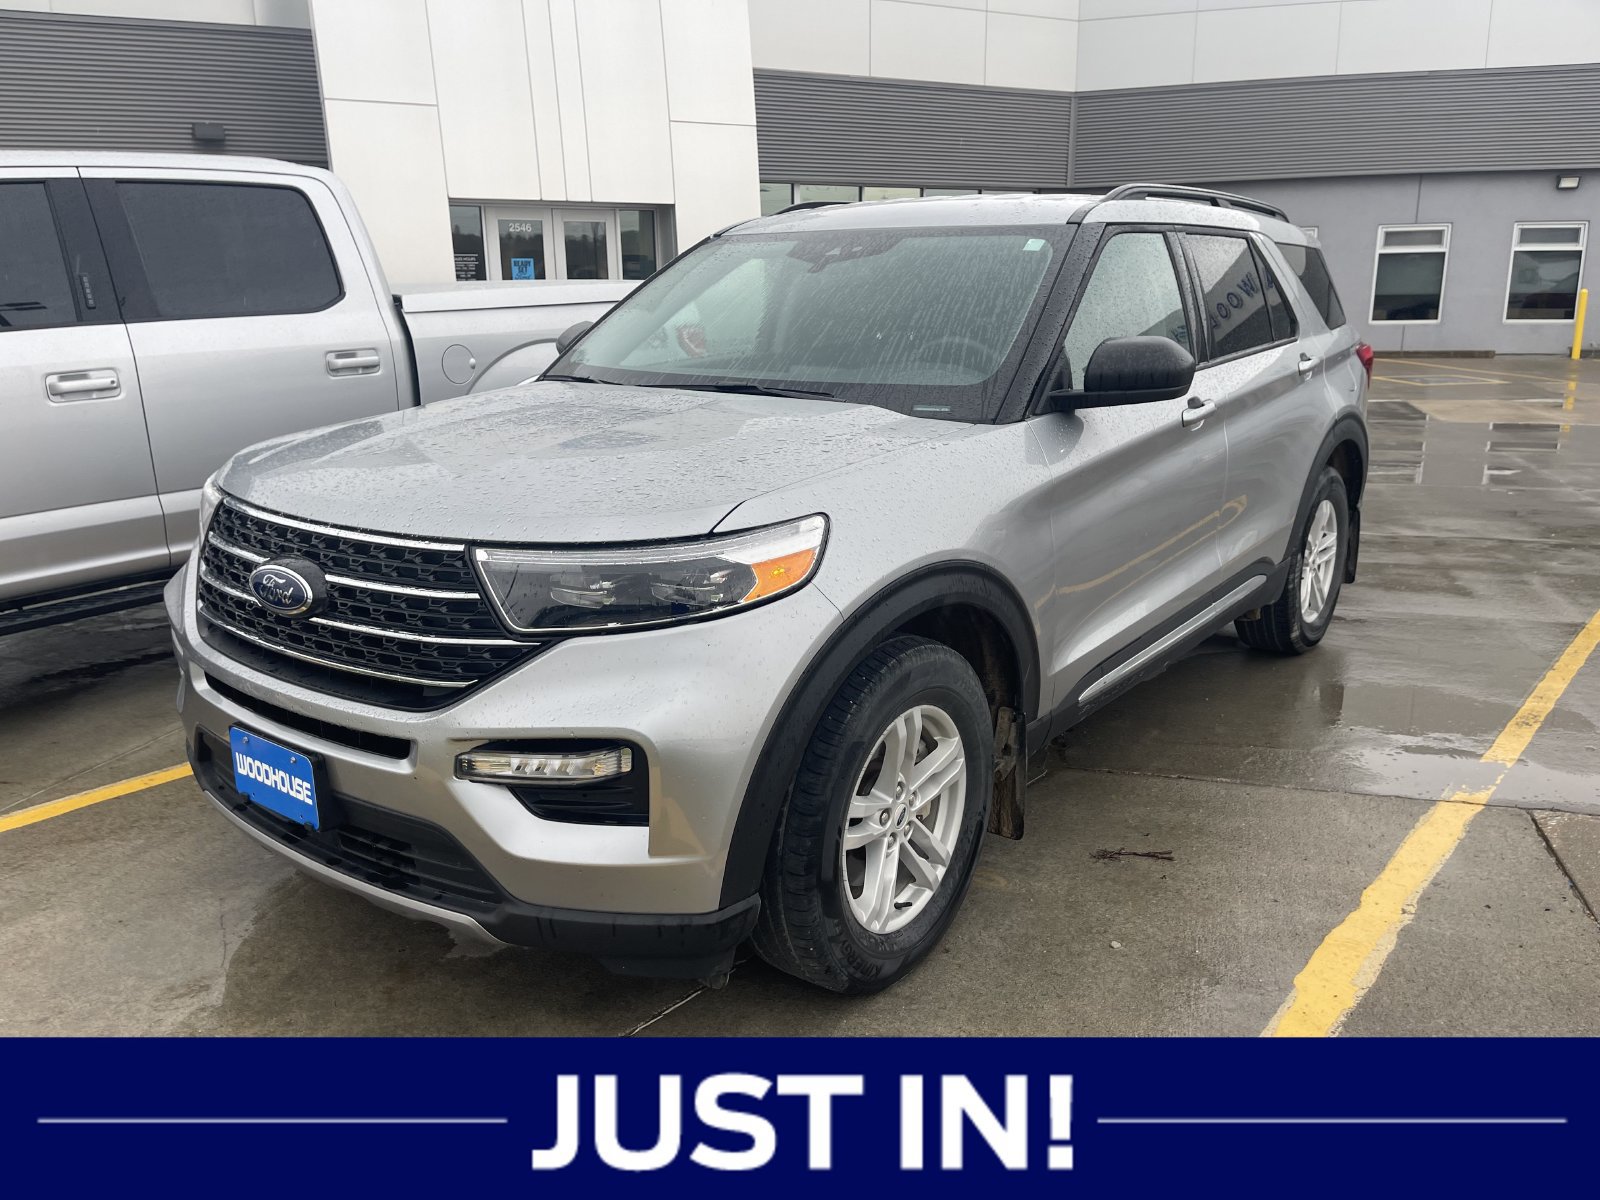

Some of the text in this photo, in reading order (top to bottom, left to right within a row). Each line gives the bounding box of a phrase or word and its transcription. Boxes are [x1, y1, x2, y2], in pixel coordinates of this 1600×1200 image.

[508, 223, 532, 232] 2546
[260, 574, 294, 605] Ford
[235, 751, 313, 806] WOODHOUSE
